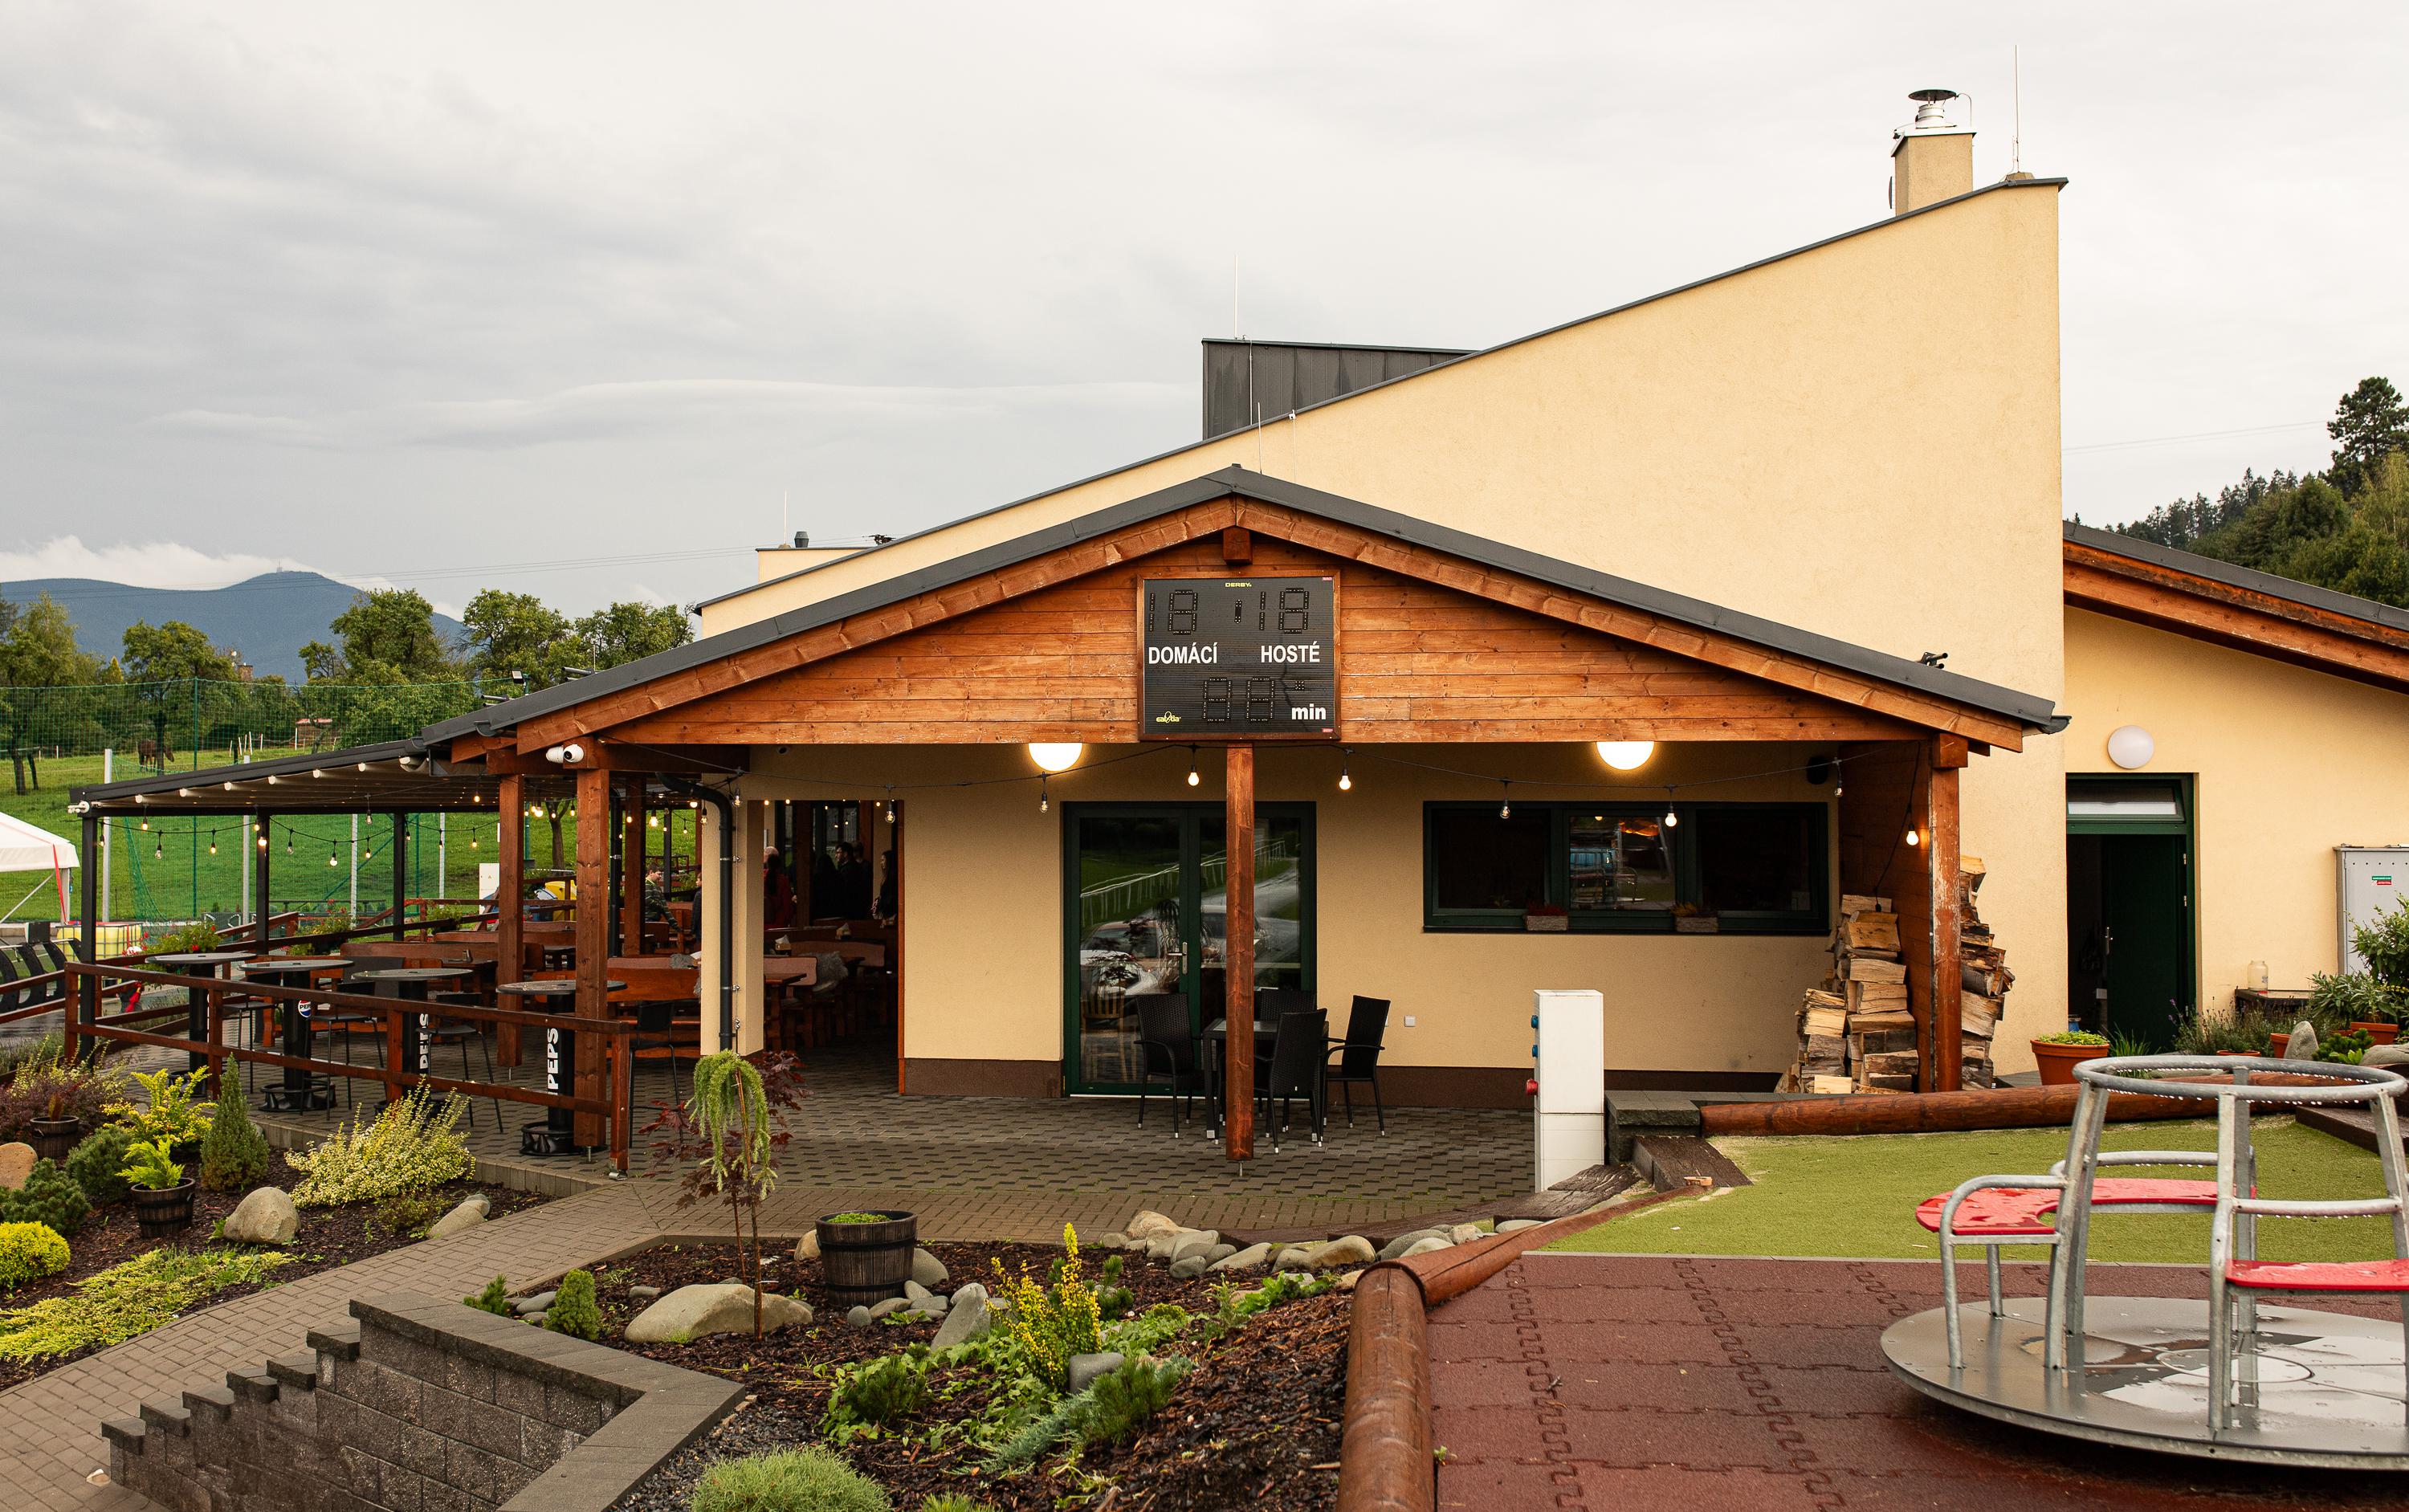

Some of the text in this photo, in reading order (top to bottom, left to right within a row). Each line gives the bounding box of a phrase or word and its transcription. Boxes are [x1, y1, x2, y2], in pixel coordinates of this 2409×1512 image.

[1148, 642, 1320, 664] DOMÁCÍ HOSTÉ
[1291, 703, 1327, 720] min
[547, 1028, 559, 1090] PEPS
